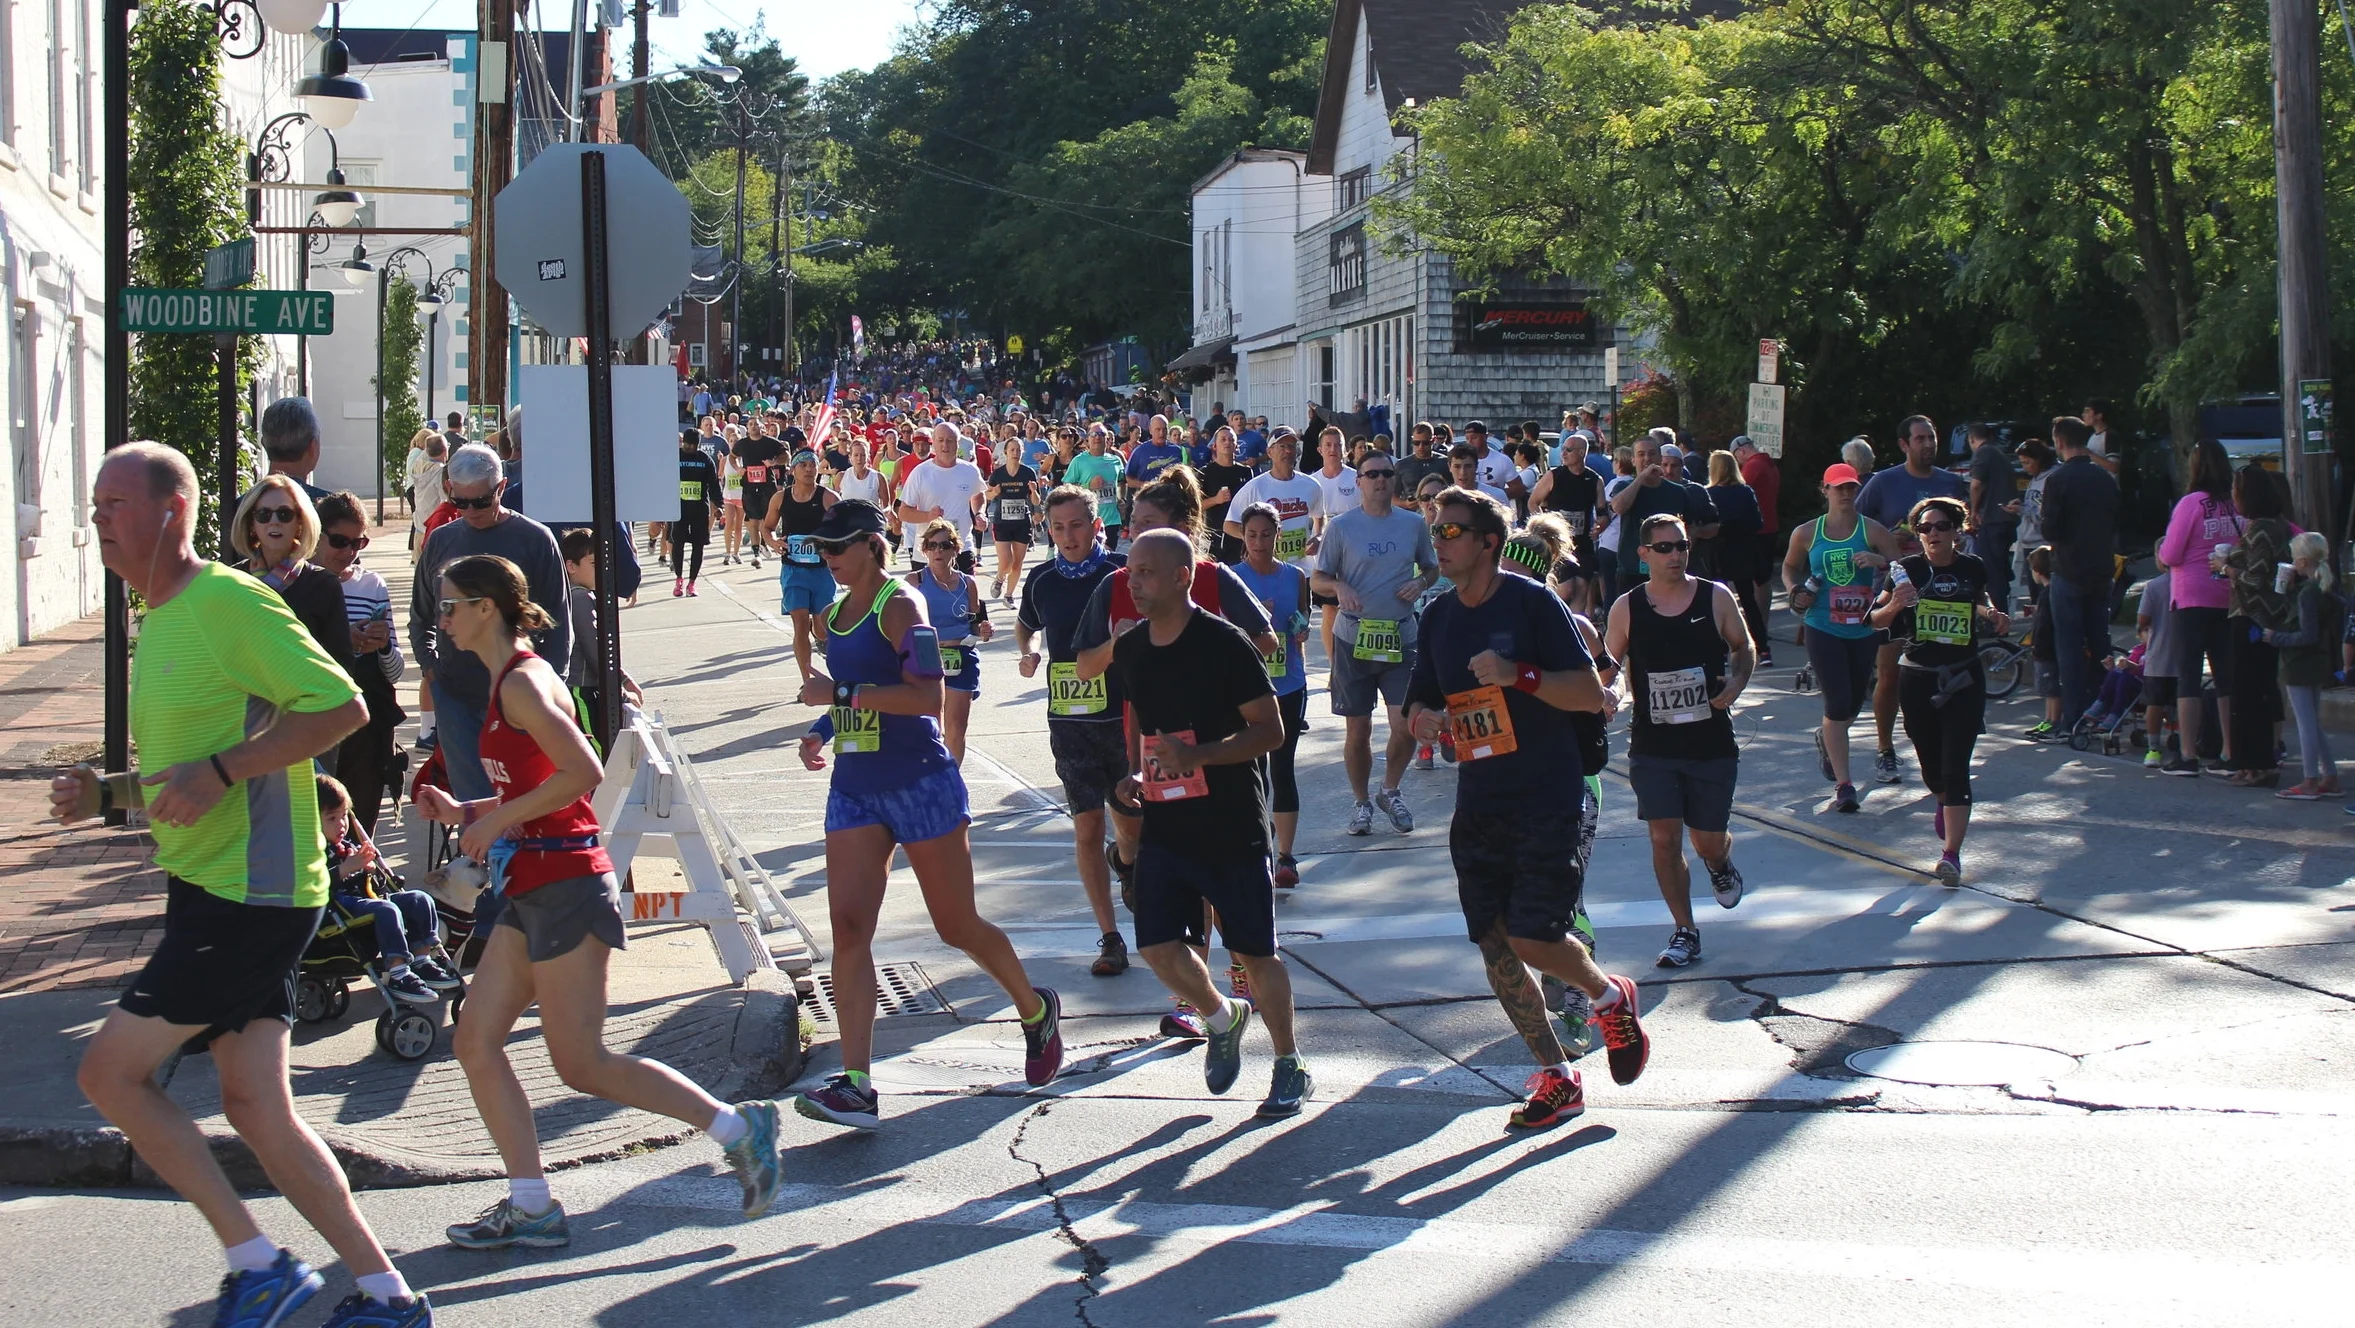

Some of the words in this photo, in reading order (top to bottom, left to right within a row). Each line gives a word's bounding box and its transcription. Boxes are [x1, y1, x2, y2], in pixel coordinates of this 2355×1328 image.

[237, 244, 252, 277] AVE
[126, 294, 257, 328] WOODBINE
[277, 297, 326, 328] AVE
[1484, 311, 1588, 324] MERCURY
[1002, 506, 1026, 515] 11255
[789, 542, 818, 555] 1200
[1830, 553, 1848, 562] NYC
[1918, 615, 1969, 635] 10023
[1357, 633, 1401, 651] 10099
[1052, 679, 1105, 700] 10221
[1651, 684, 1708, 711] 11202
[634, 892, 684, 919] NPT
